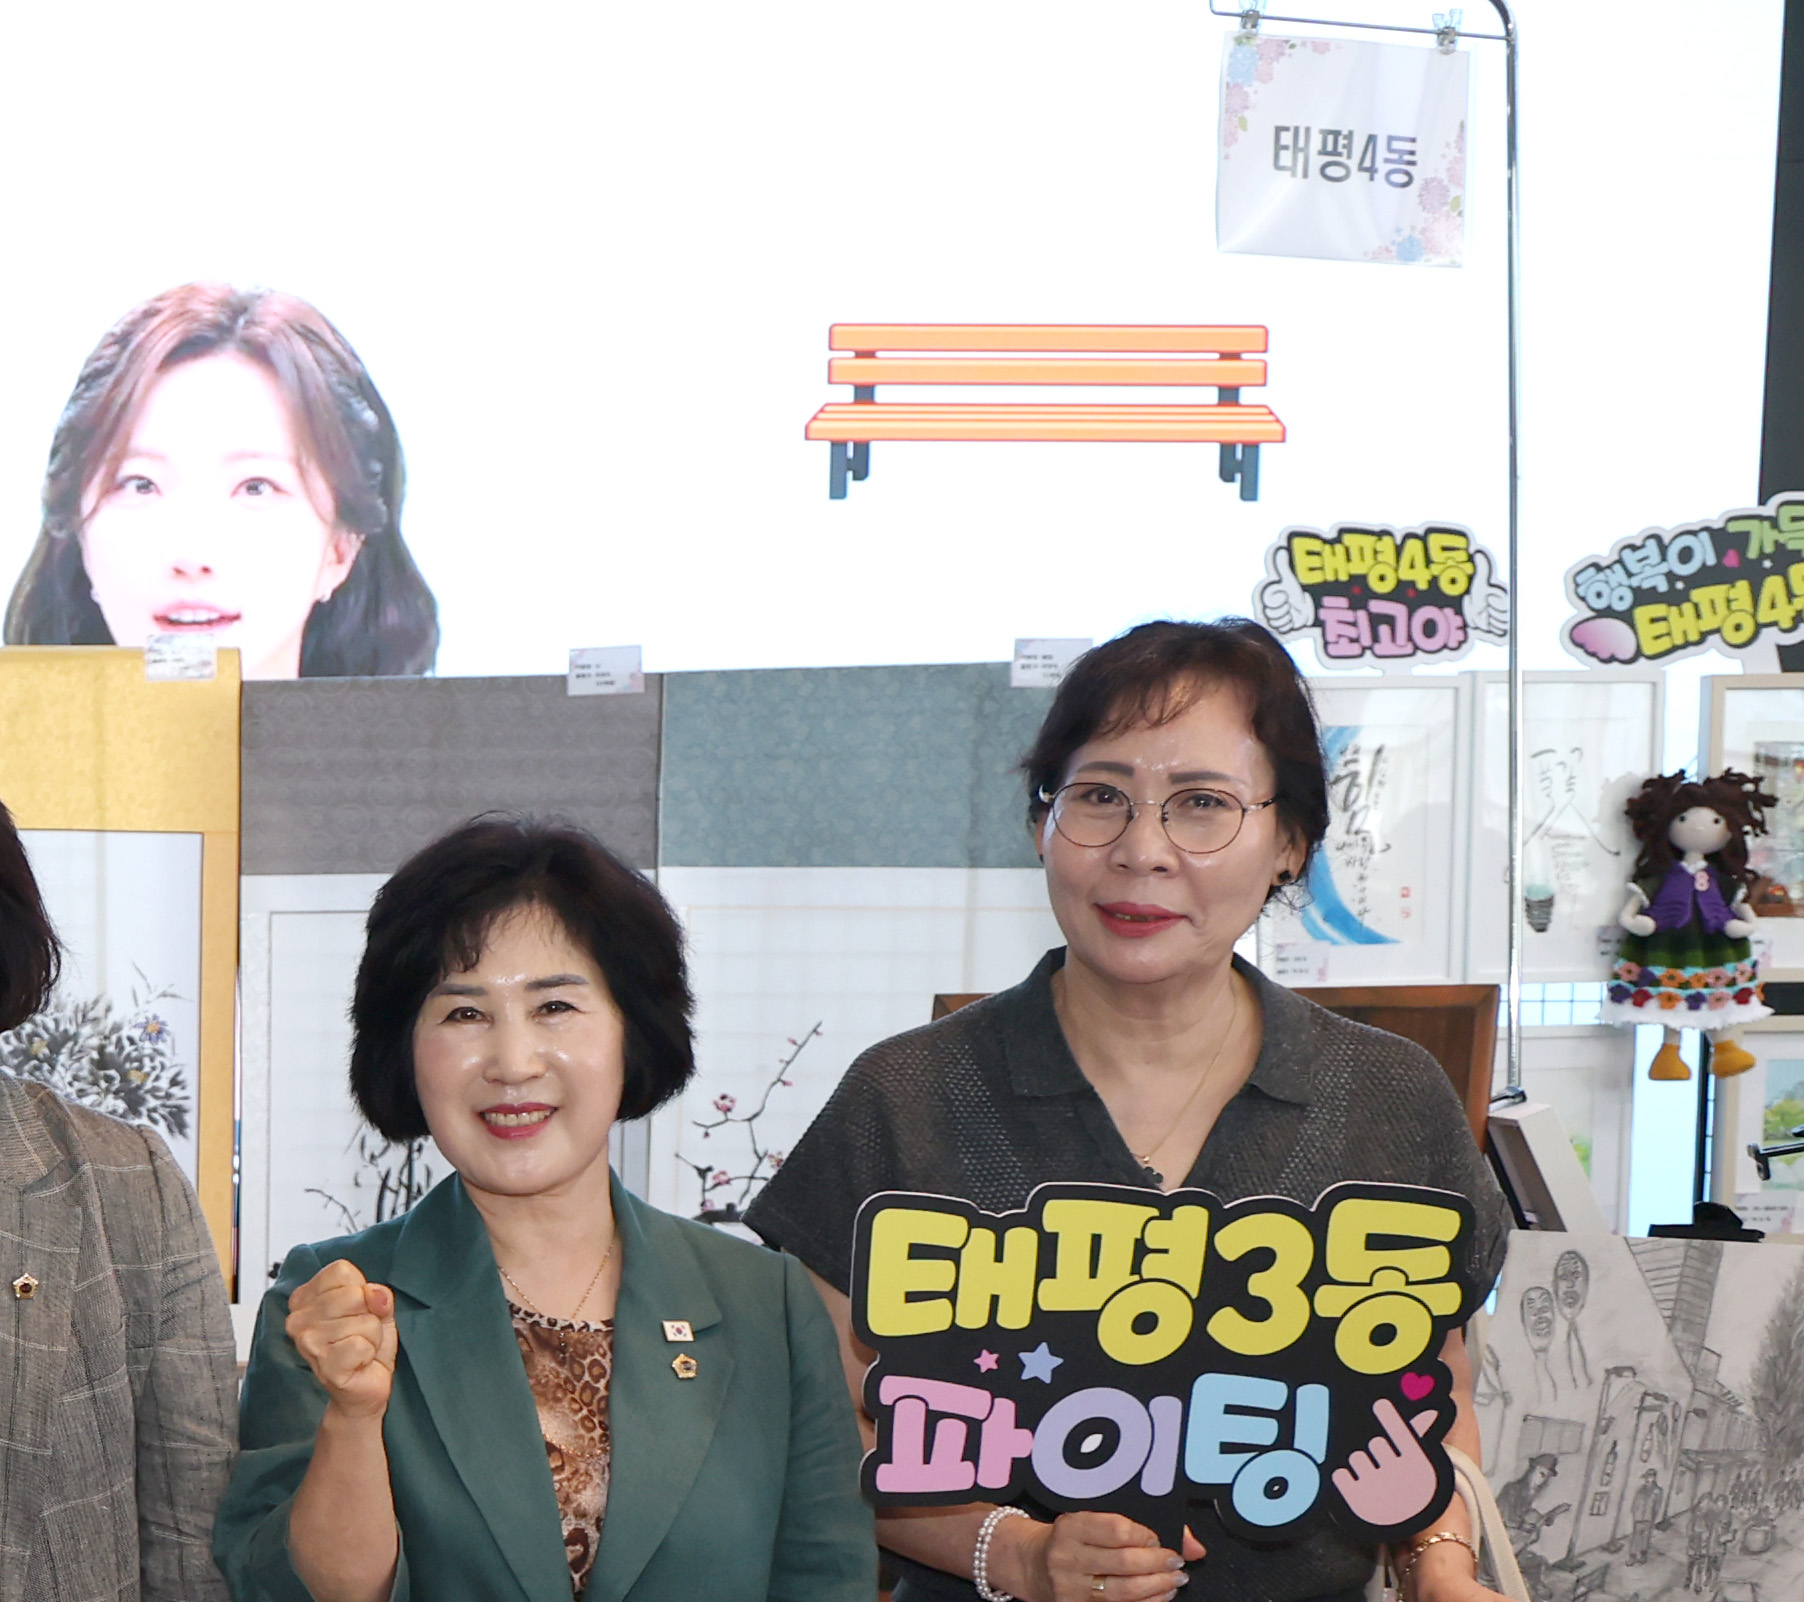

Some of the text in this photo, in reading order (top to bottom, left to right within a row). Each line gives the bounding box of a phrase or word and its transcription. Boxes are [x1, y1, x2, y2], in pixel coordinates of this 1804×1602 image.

[1273, 125, 1417, 189] 태평4동
[1290, 530, 1475, 597] 태평4동
[1575, 531, 1717, 611] 행복이
[1318, 596, 1465, 657] 최고야
[869, 1198, 1462, 1376] 태평3동
[876, 1371, 1330, 1527] 파이팅
